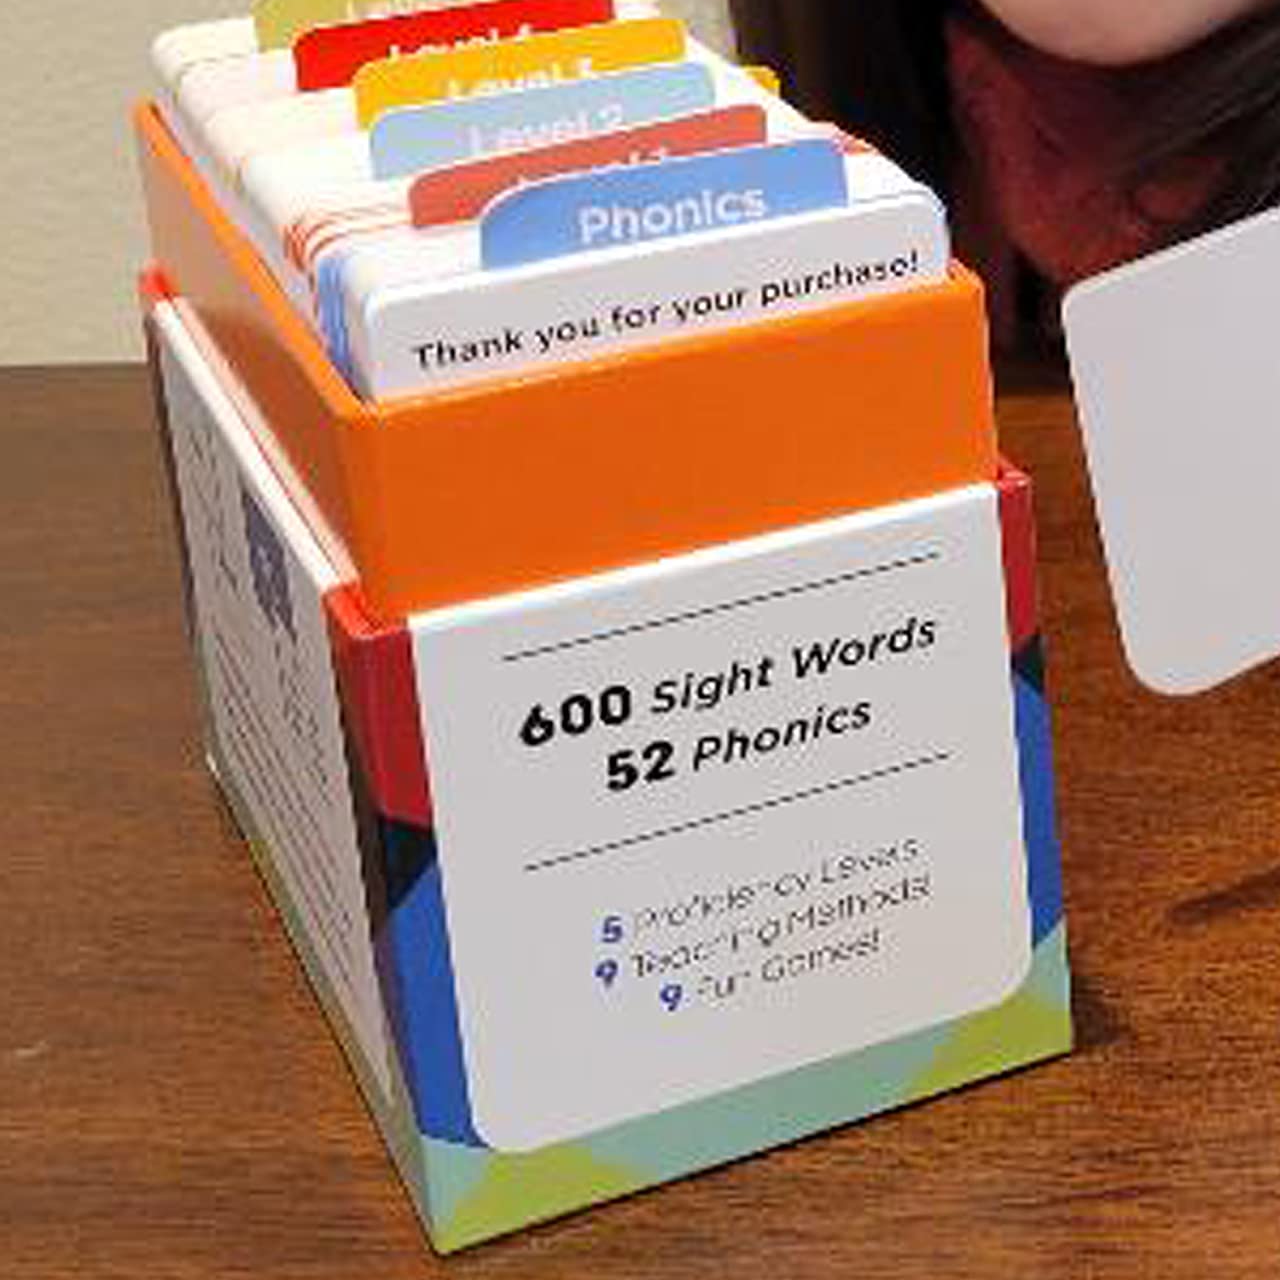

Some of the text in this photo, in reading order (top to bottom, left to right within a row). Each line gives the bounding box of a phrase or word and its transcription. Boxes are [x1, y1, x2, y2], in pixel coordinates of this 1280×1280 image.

[578, 188, 767, 244] Phonics
[414, 249, 919, 370] Thank you for your purchase!
[519, 617, 937, 747] 600 Sight Words
[607, 701, 872, 791] 52 Phonics
[601, 915, 623, 945] 5
[594, 958, 619, 989] 9
[659, 982, 683, 1012] 9
